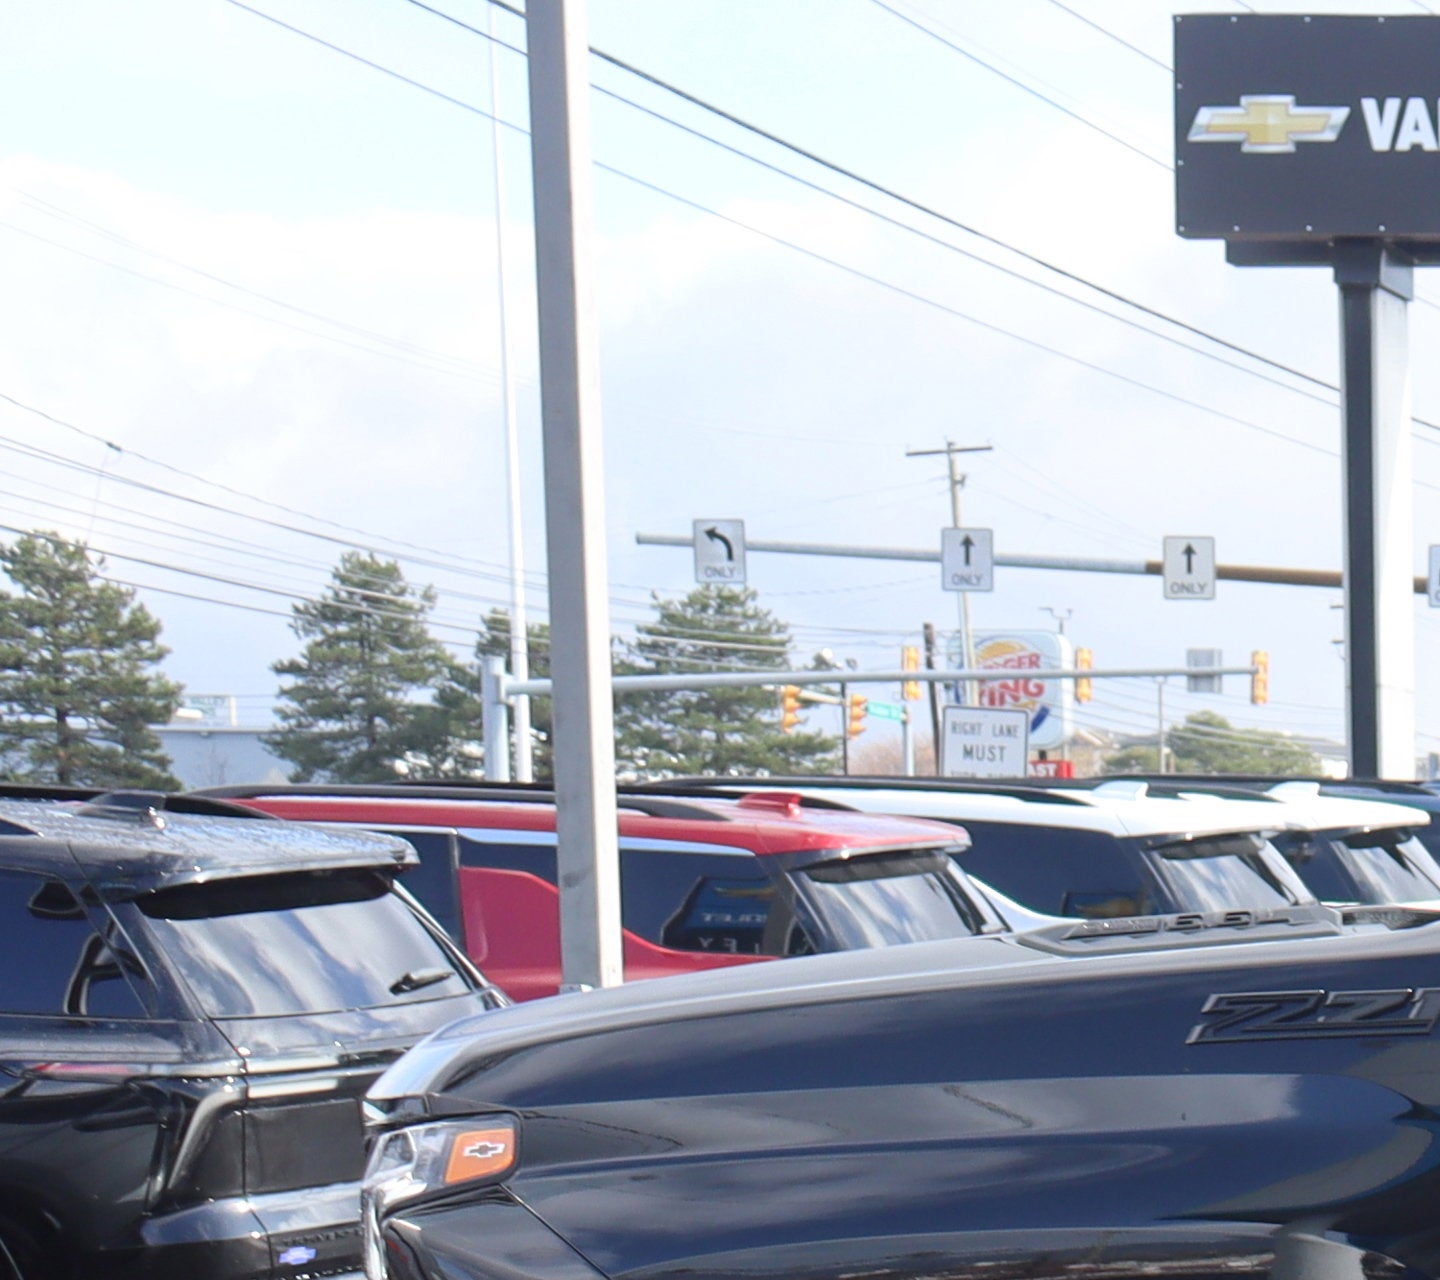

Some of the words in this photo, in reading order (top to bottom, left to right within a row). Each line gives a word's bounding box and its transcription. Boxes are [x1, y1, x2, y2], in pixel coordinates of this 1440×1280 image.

[704, 566, 735, 579] ONLY
[951, 573, 982, 586] ONLY
[1170, 581, 1208, 594] ONLY
[951, 721, 982, 736] RIGHT
[992, 723, 1019, 738] LANE
[962, 744, 1006, 761] MUST
